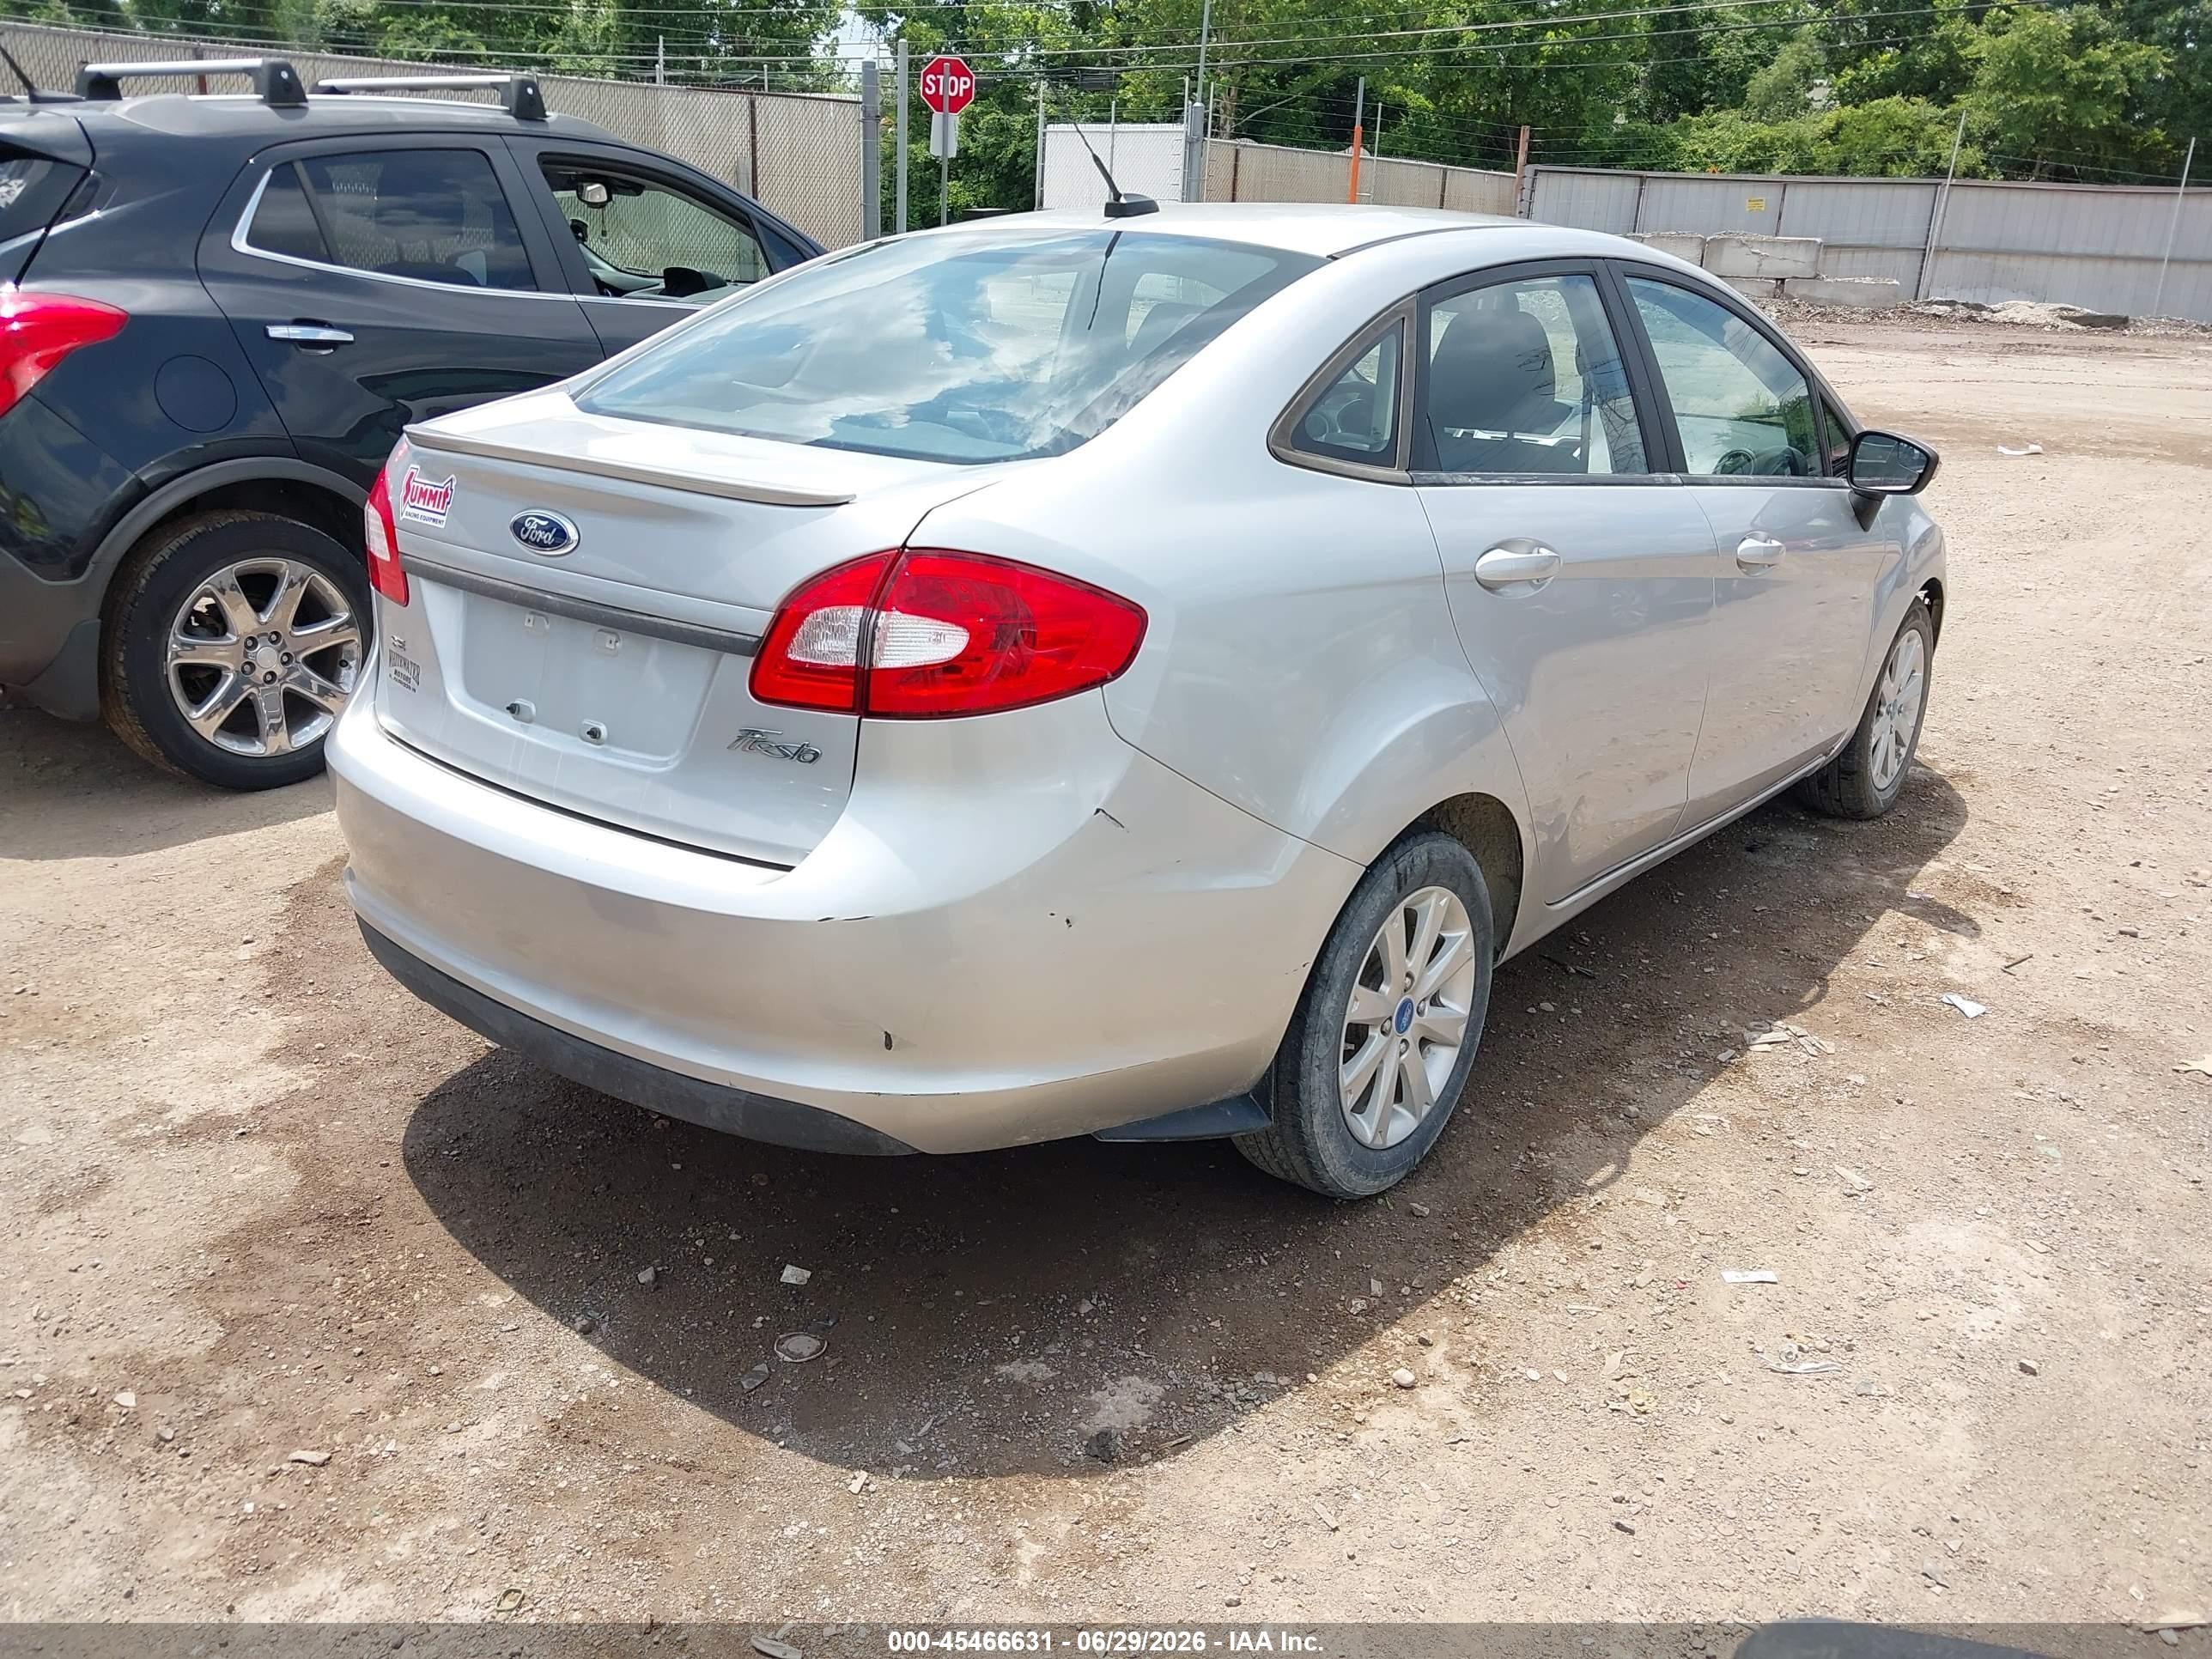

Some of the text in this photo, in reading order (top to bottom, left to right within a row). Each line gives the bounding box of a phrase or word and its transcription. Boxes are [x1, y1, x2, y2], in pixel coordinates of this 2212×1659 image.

[924, 74, 971, 97] STOP
[403, 471, 450, 511] SUMMIT
[419, 514, 445, 526] EQUIPMENT
[520, 517, 556, 544] Ford
[726, 727, 823, 765] Fiesta
